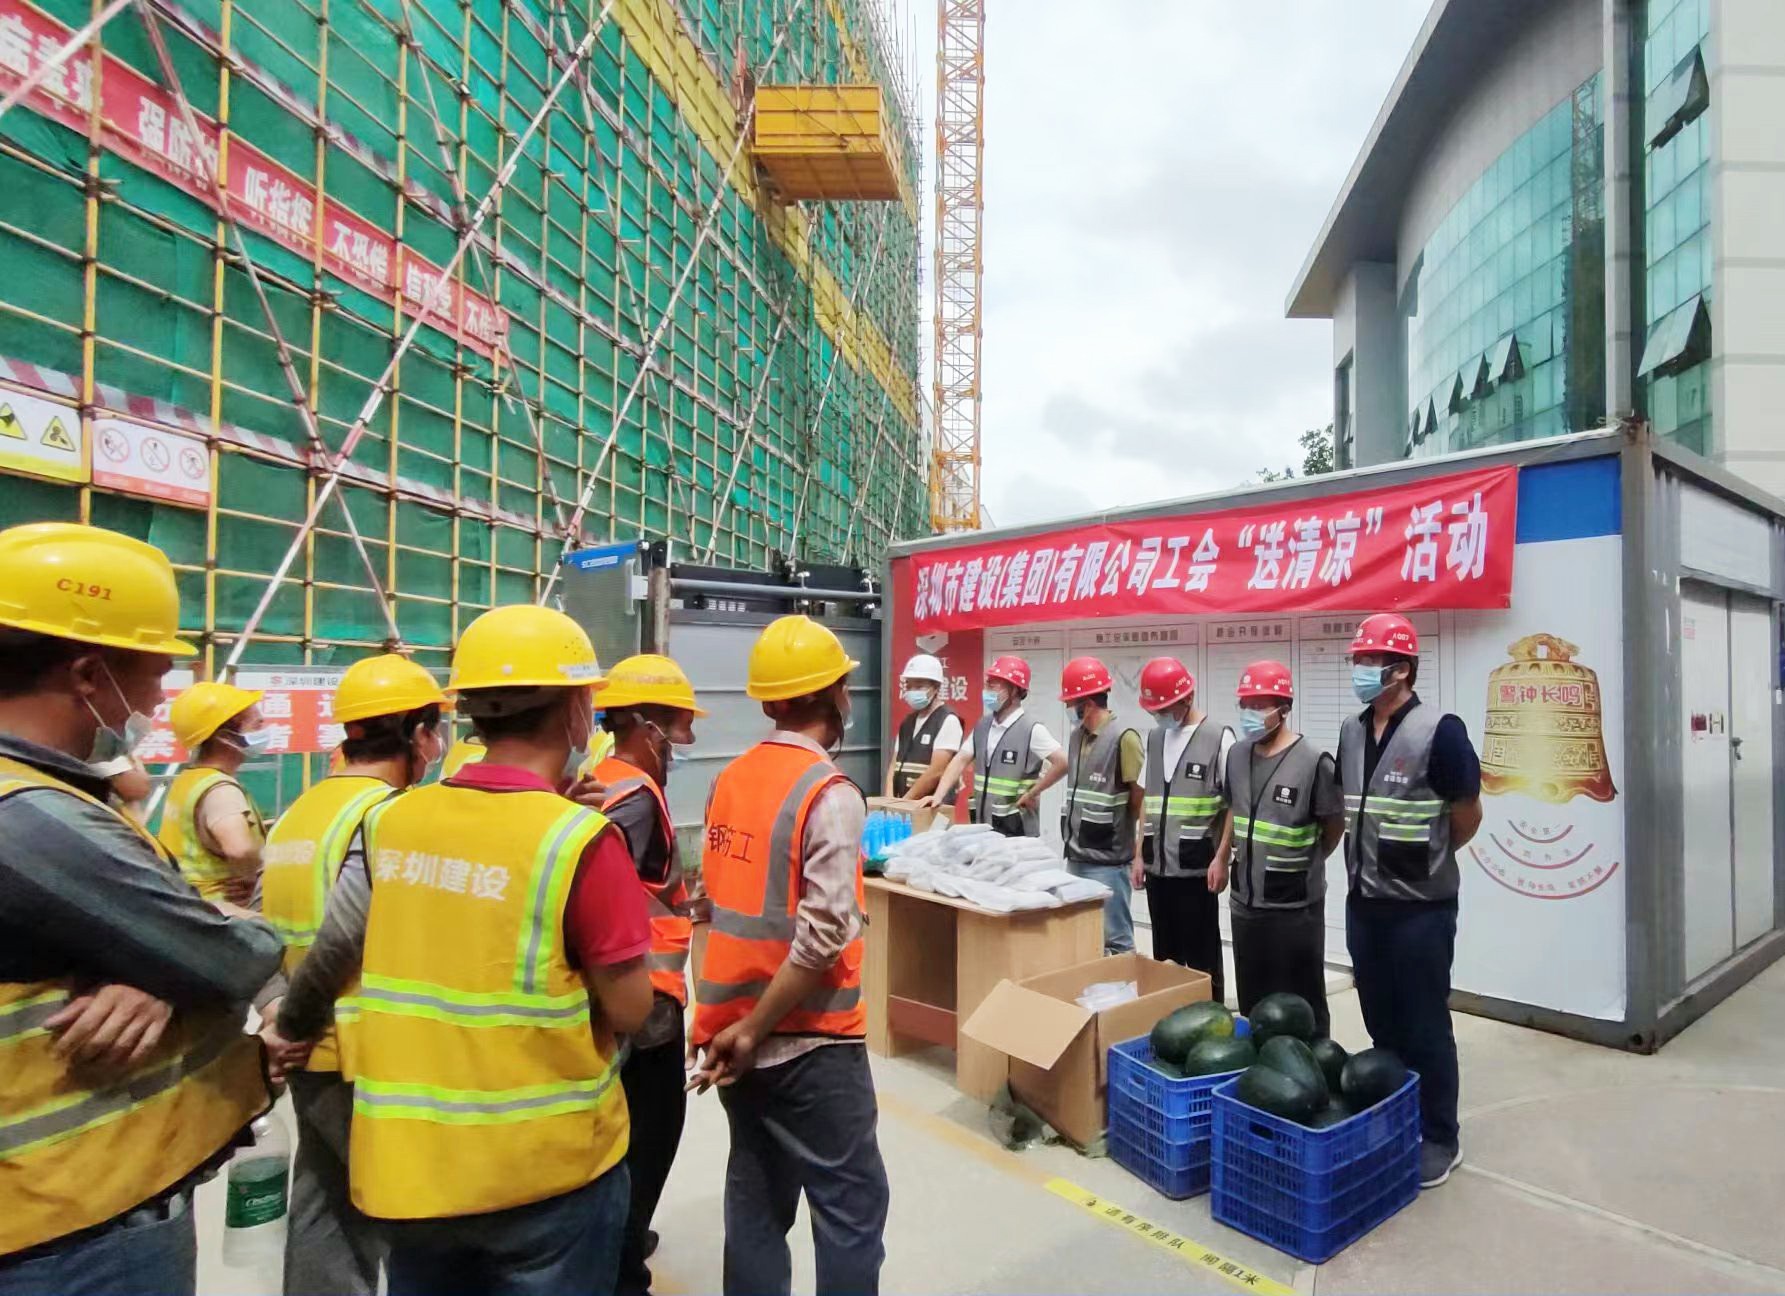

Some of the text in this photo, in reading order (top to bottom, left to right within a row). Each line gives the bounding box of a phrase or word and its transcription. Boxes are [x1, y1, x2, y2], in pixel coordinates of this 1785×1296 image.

[244, 167, 314, 250] 听指挥
[1400, 492, 1488, 583] 活动
[57, 578, 113, 601] C191
[1499, 685, 1581, 703] 警钟长鸣
[375, 847, 511, 901] 深圳建设
